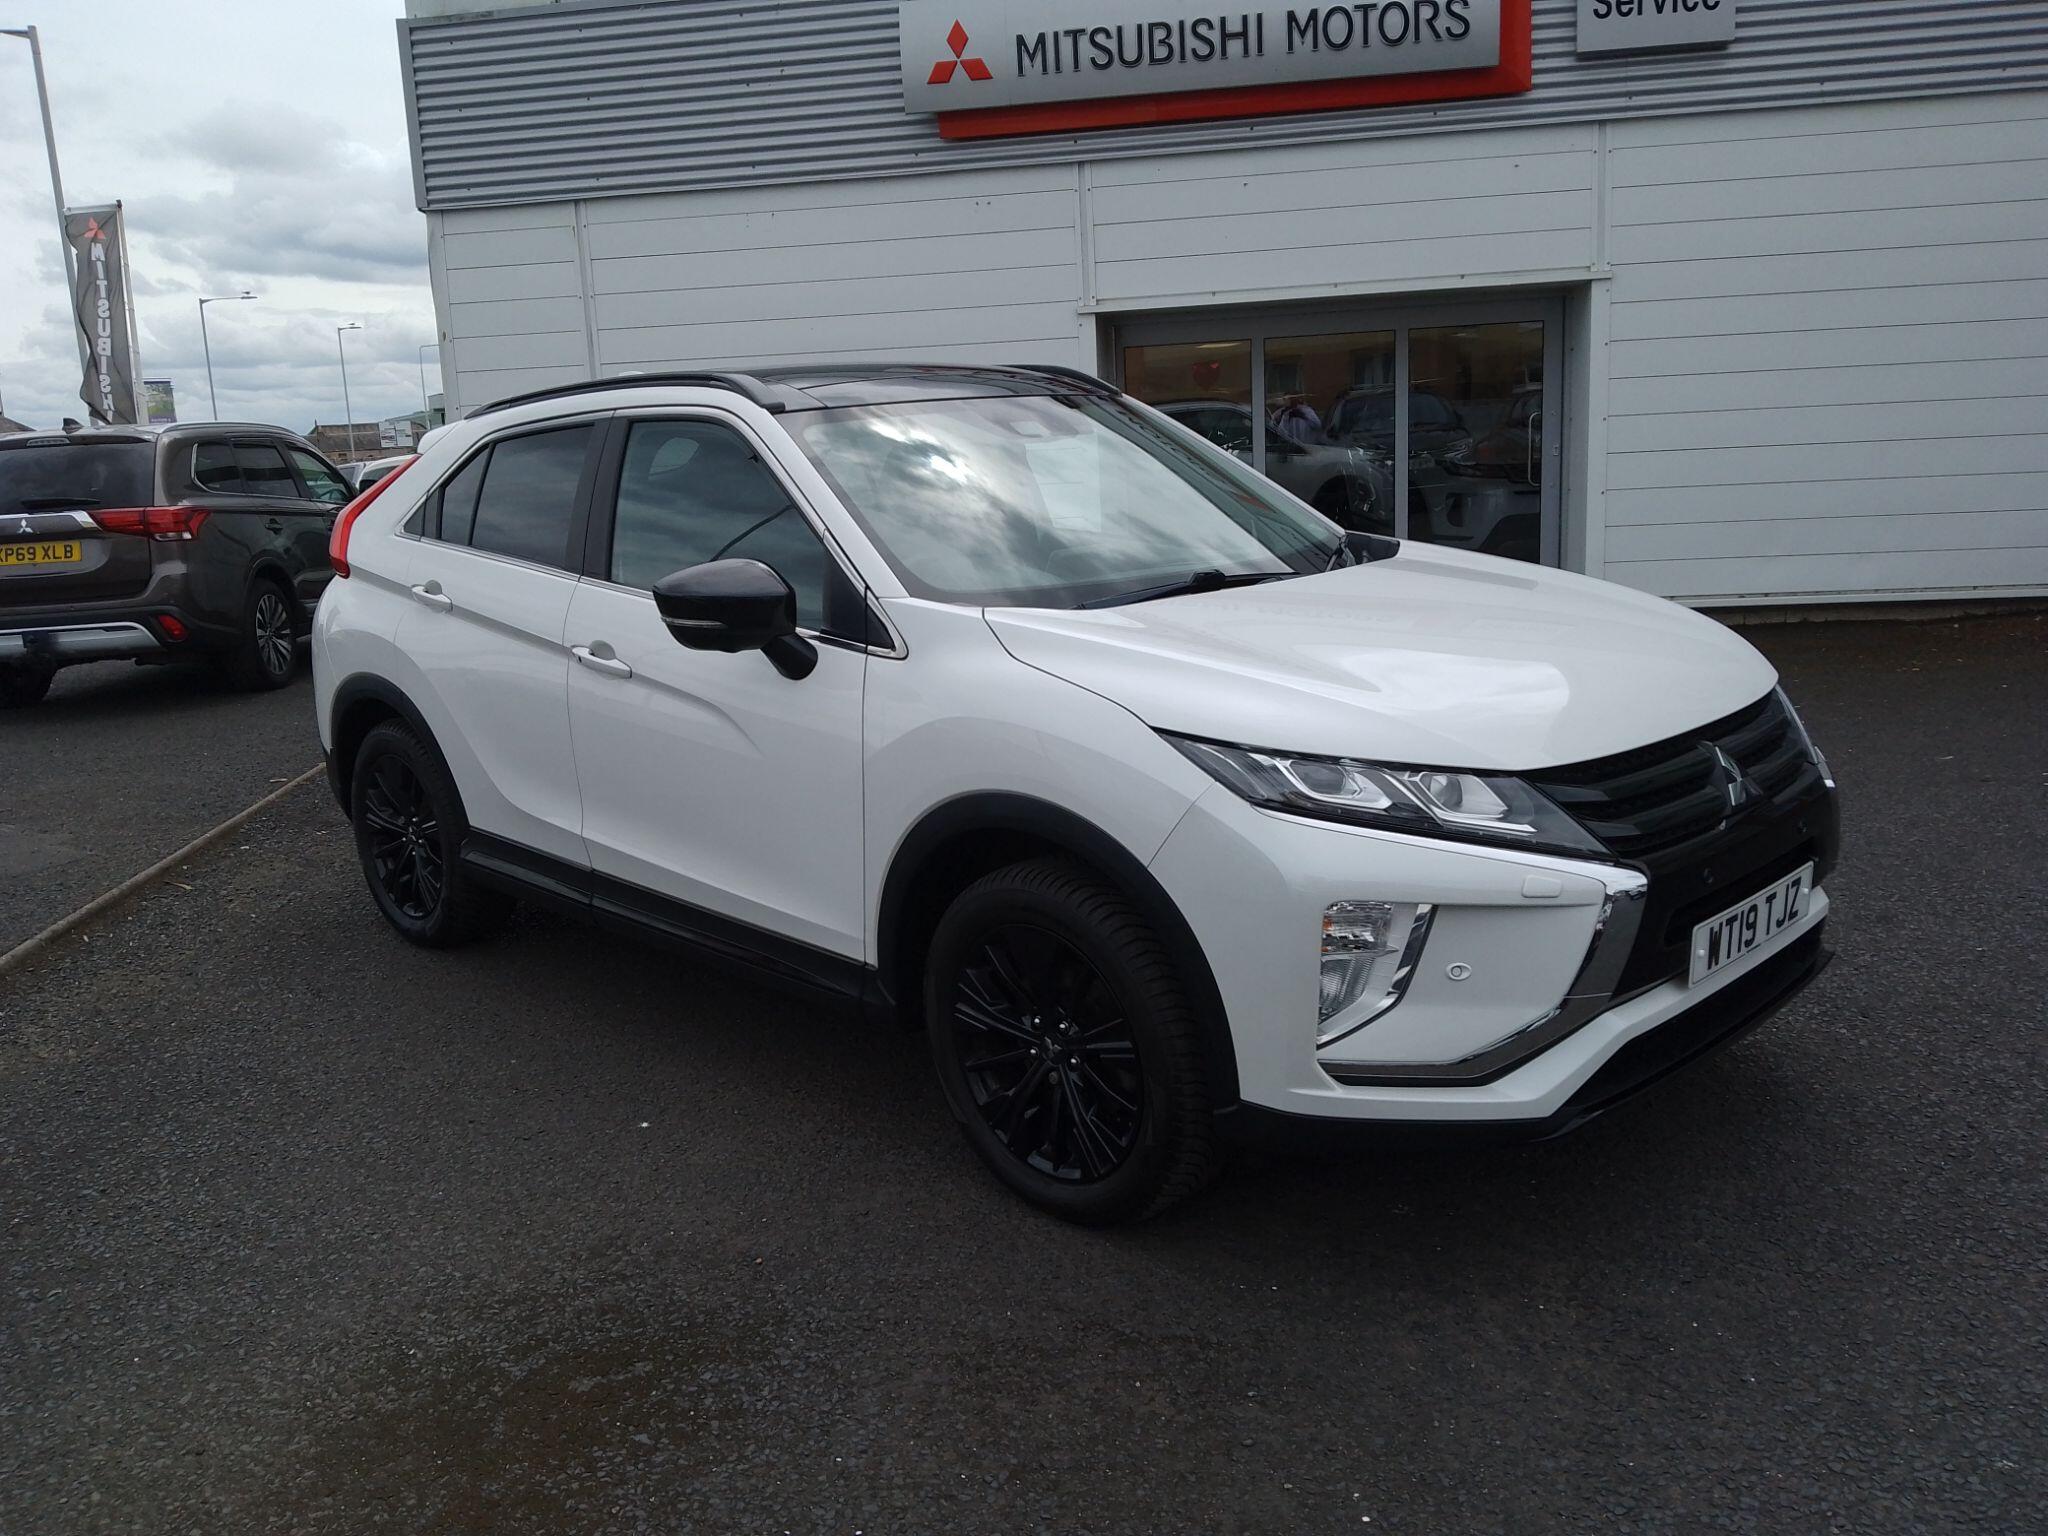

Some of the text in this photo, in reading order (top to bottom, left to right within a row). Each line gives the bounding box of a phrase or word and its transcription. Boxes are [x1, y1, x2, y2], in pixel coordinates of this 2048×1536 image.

[1015, 0, 1472, 76] MITSUBISHI MOTORS
[41, 544, 74, 560] XLB
[1707, 876, 1802, 970] WT19 TJZ
